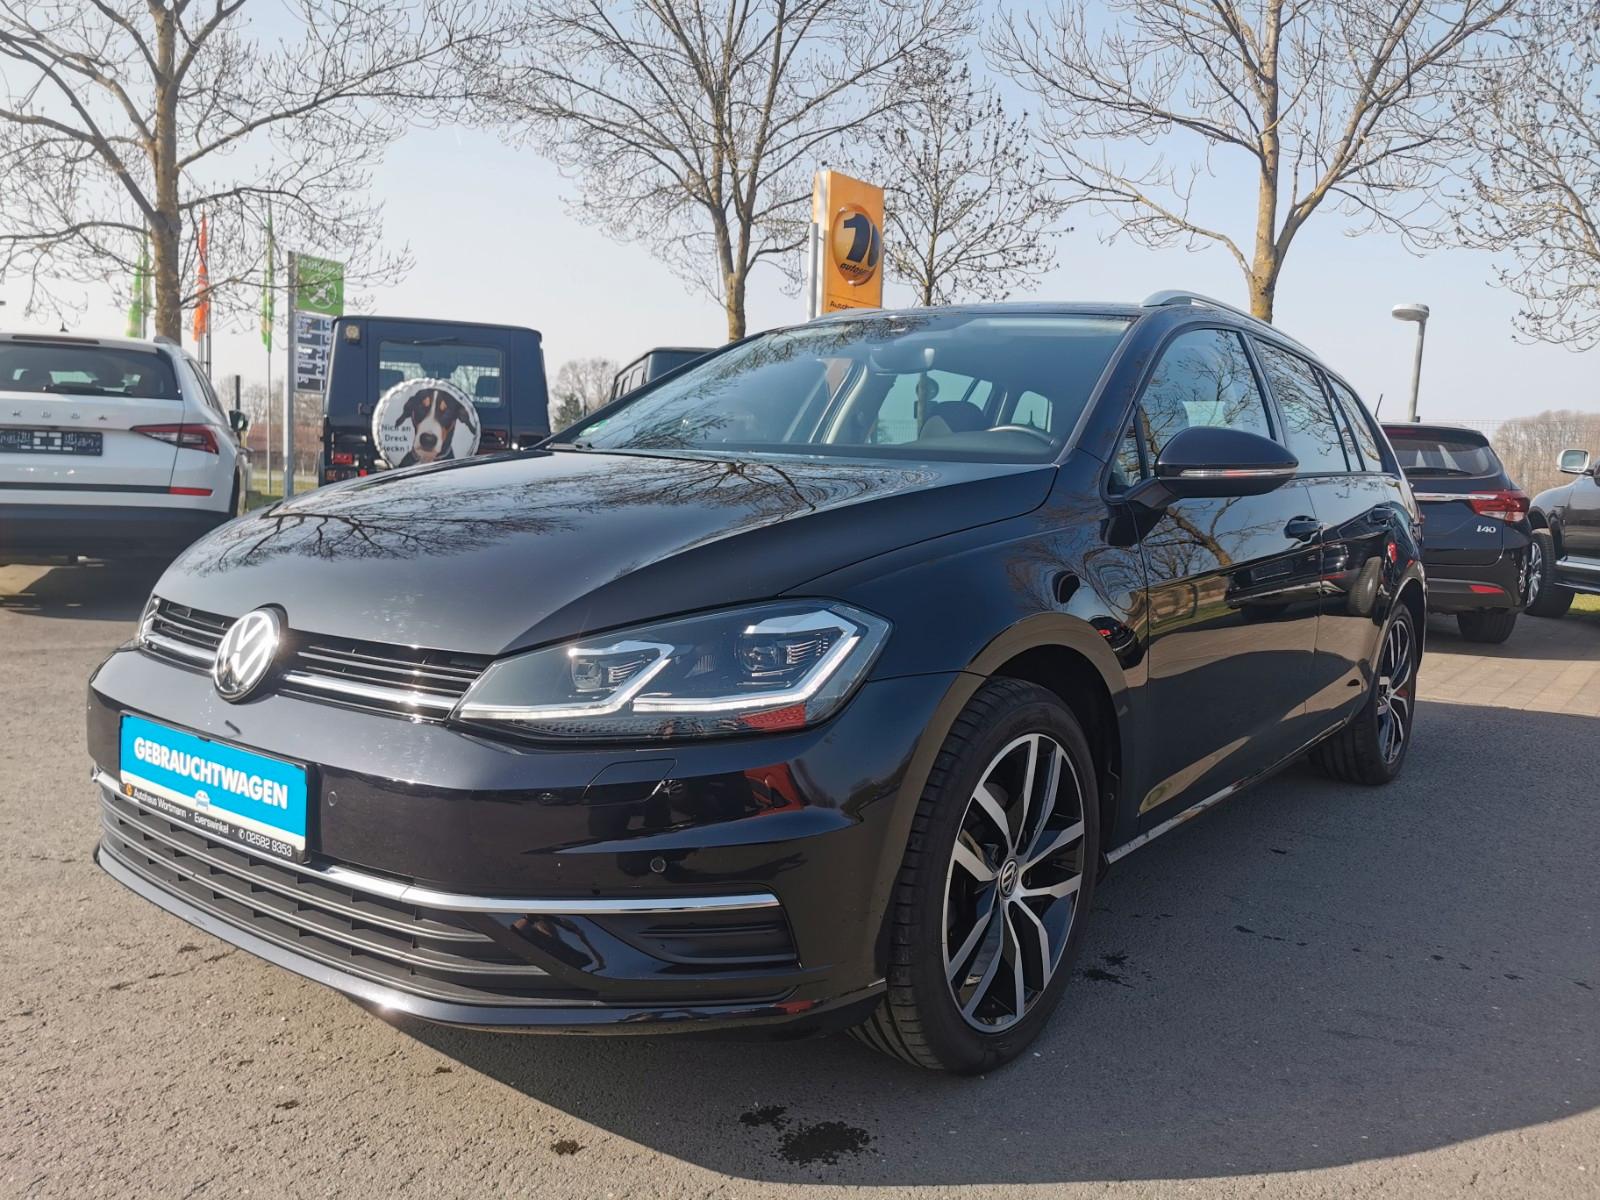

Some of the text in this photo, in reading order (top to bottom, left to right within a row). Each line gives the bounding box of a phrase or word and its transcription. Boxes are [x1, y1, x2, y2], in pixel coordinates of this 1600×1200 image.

[134, 736, 288, 810] GEBRAUCHTWAGEN
[133, 787, 158, 807] Autohaus
[158, 797, 187, 818] Wortmann
[246, 831, 270, 849] 02582
[271, 839, 292, 857] 9353
